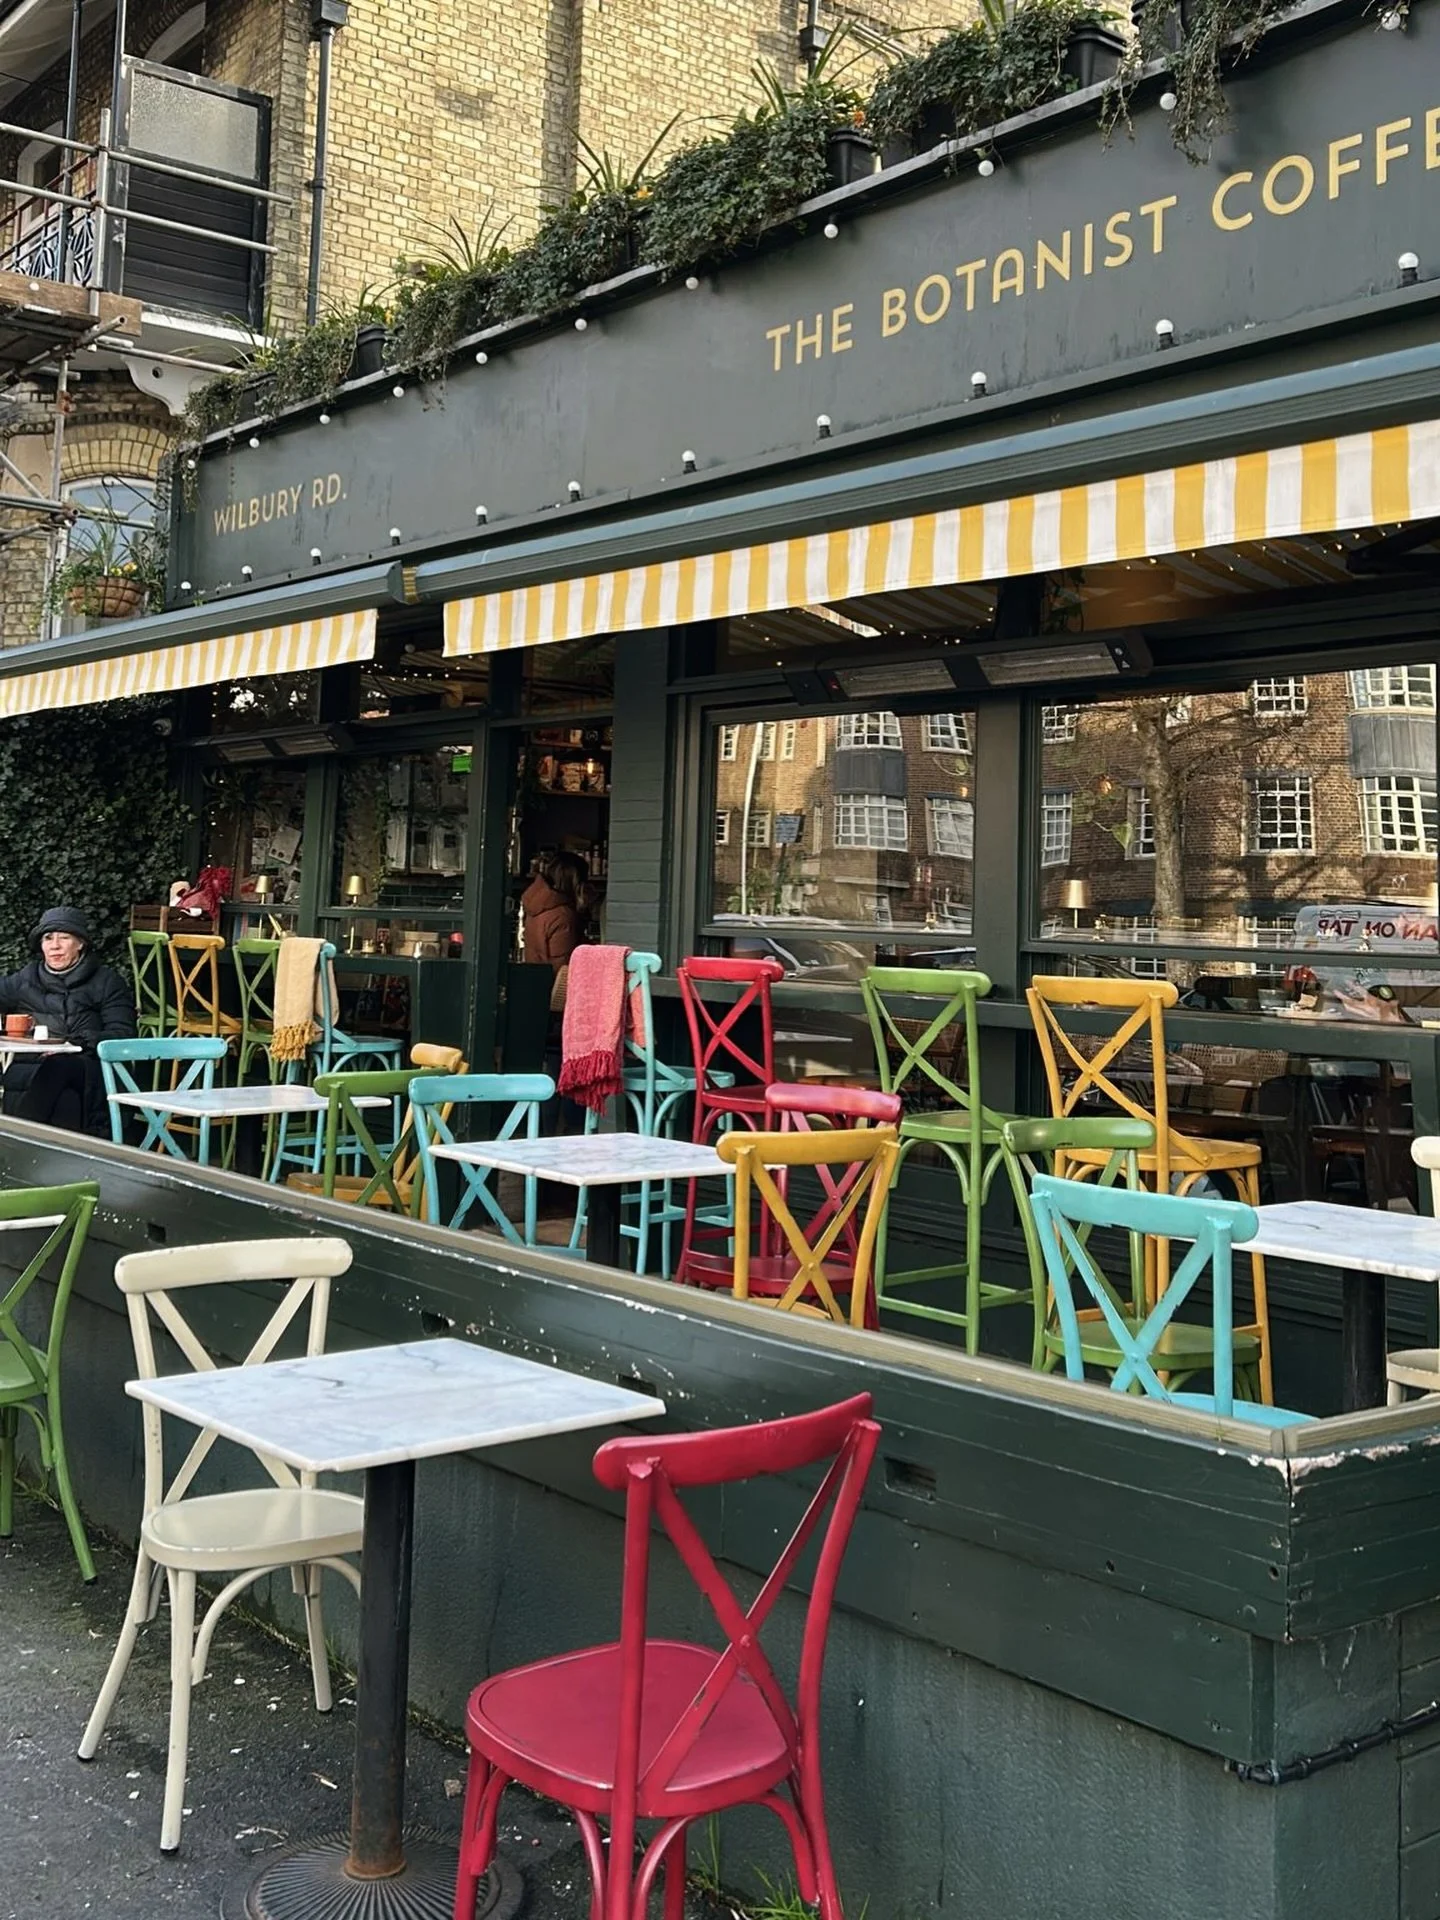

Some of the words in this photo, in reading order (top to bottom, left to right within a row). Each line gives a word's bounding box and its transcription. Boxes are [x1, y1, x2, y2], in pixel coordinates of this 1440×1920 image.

[766, 303, 854, 370] THE
[881, 195, 1178, 338] BOTANIST
[214, 484, 302, 536] WILBURY
[312, 473, 347, 508] RD.
